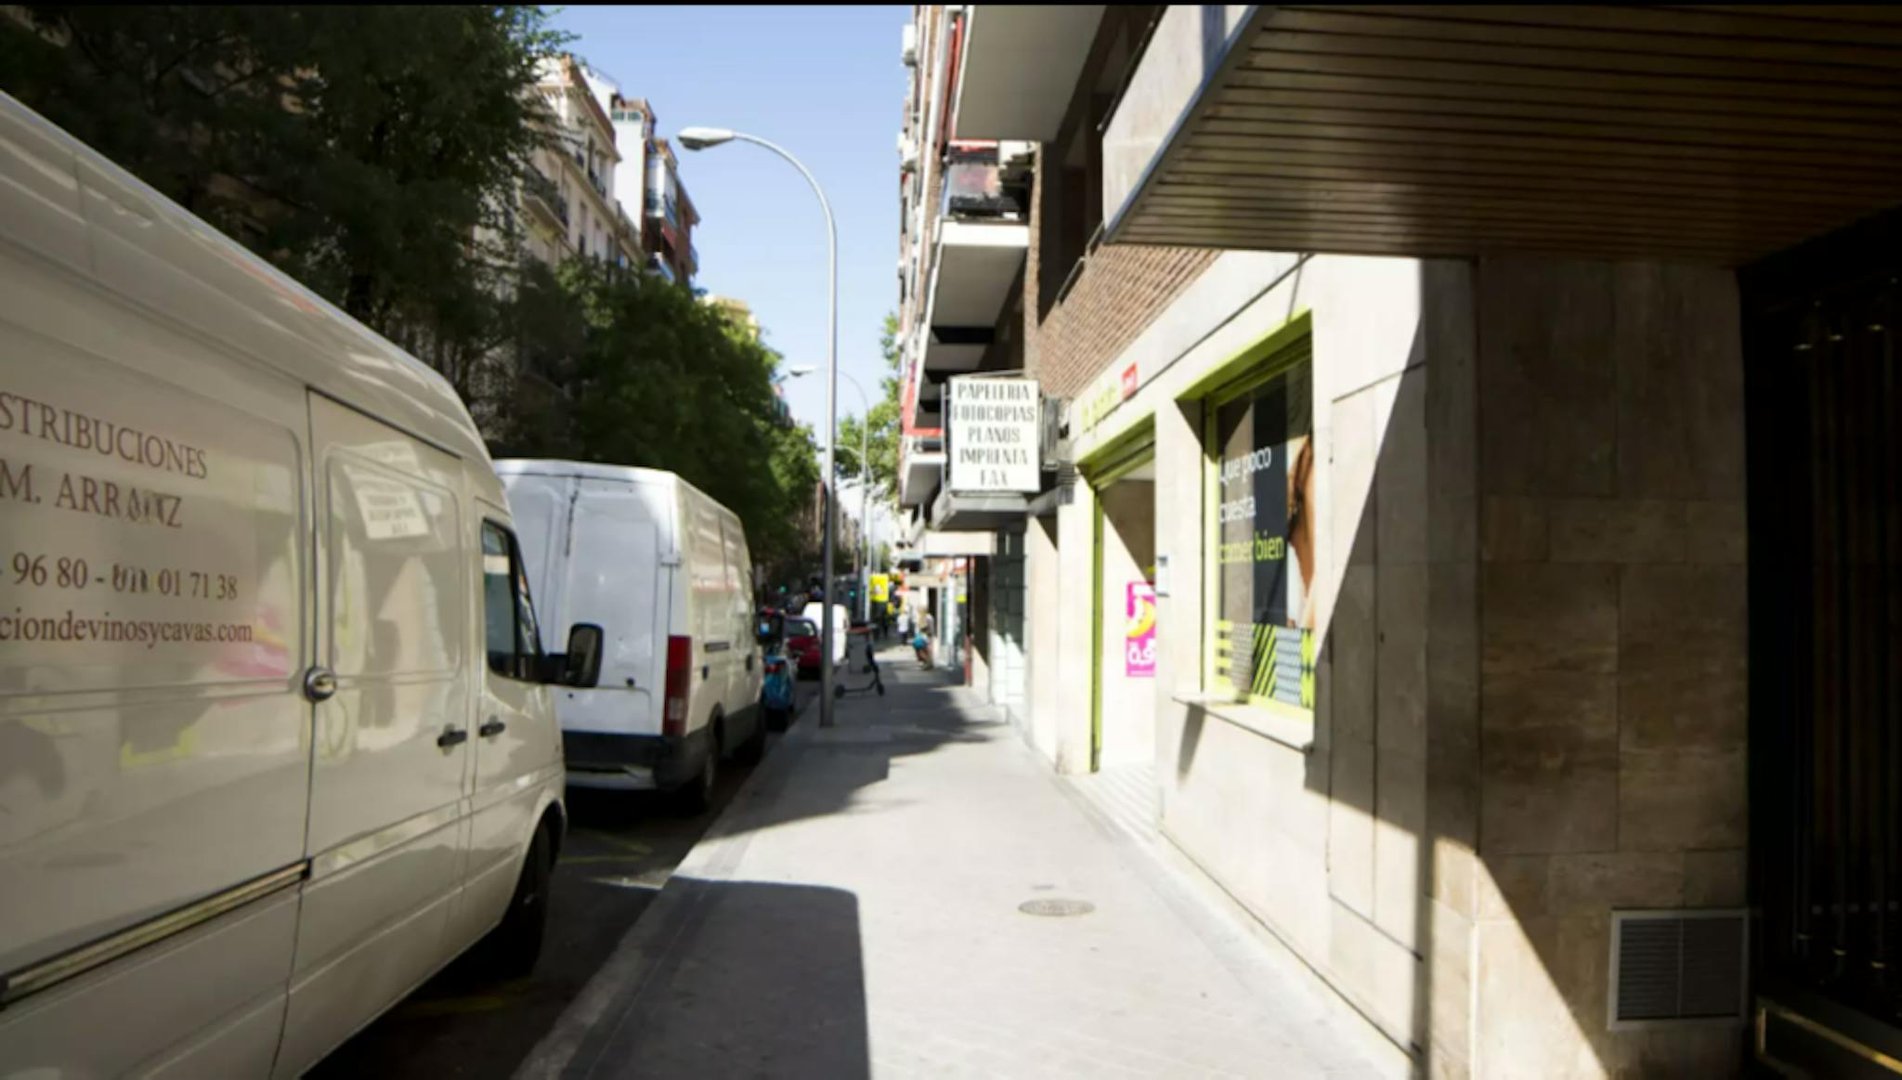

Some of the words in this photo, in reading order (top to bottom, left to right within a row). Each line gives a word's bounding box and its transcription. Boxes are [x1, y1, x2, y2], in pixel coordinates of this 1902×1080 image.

[957, 383, 1031, 401] PAPELERIA
[953, 404, 1036, 422] FOTOCOPIAS
[0, 391, 208, 480] STRIBUCIONES
[968, 427, 1021, 443] PLANOS
[960, 448, 1029, 465] IMPRENTA
[1241, 446, 1272, 483] poco
[980, 469, 1008, 486] FAX
[1254, 530, 1285, 561] bien
[12, 552, 47, 586] 96
[57, 556, 88, 589] 80
[158, 568, 180, 597] 01
[190, 571, 210, 599] 71
[216, 574, 238, 600] 38
[0, 606, 253, 650] ciondevinosycavas.com
